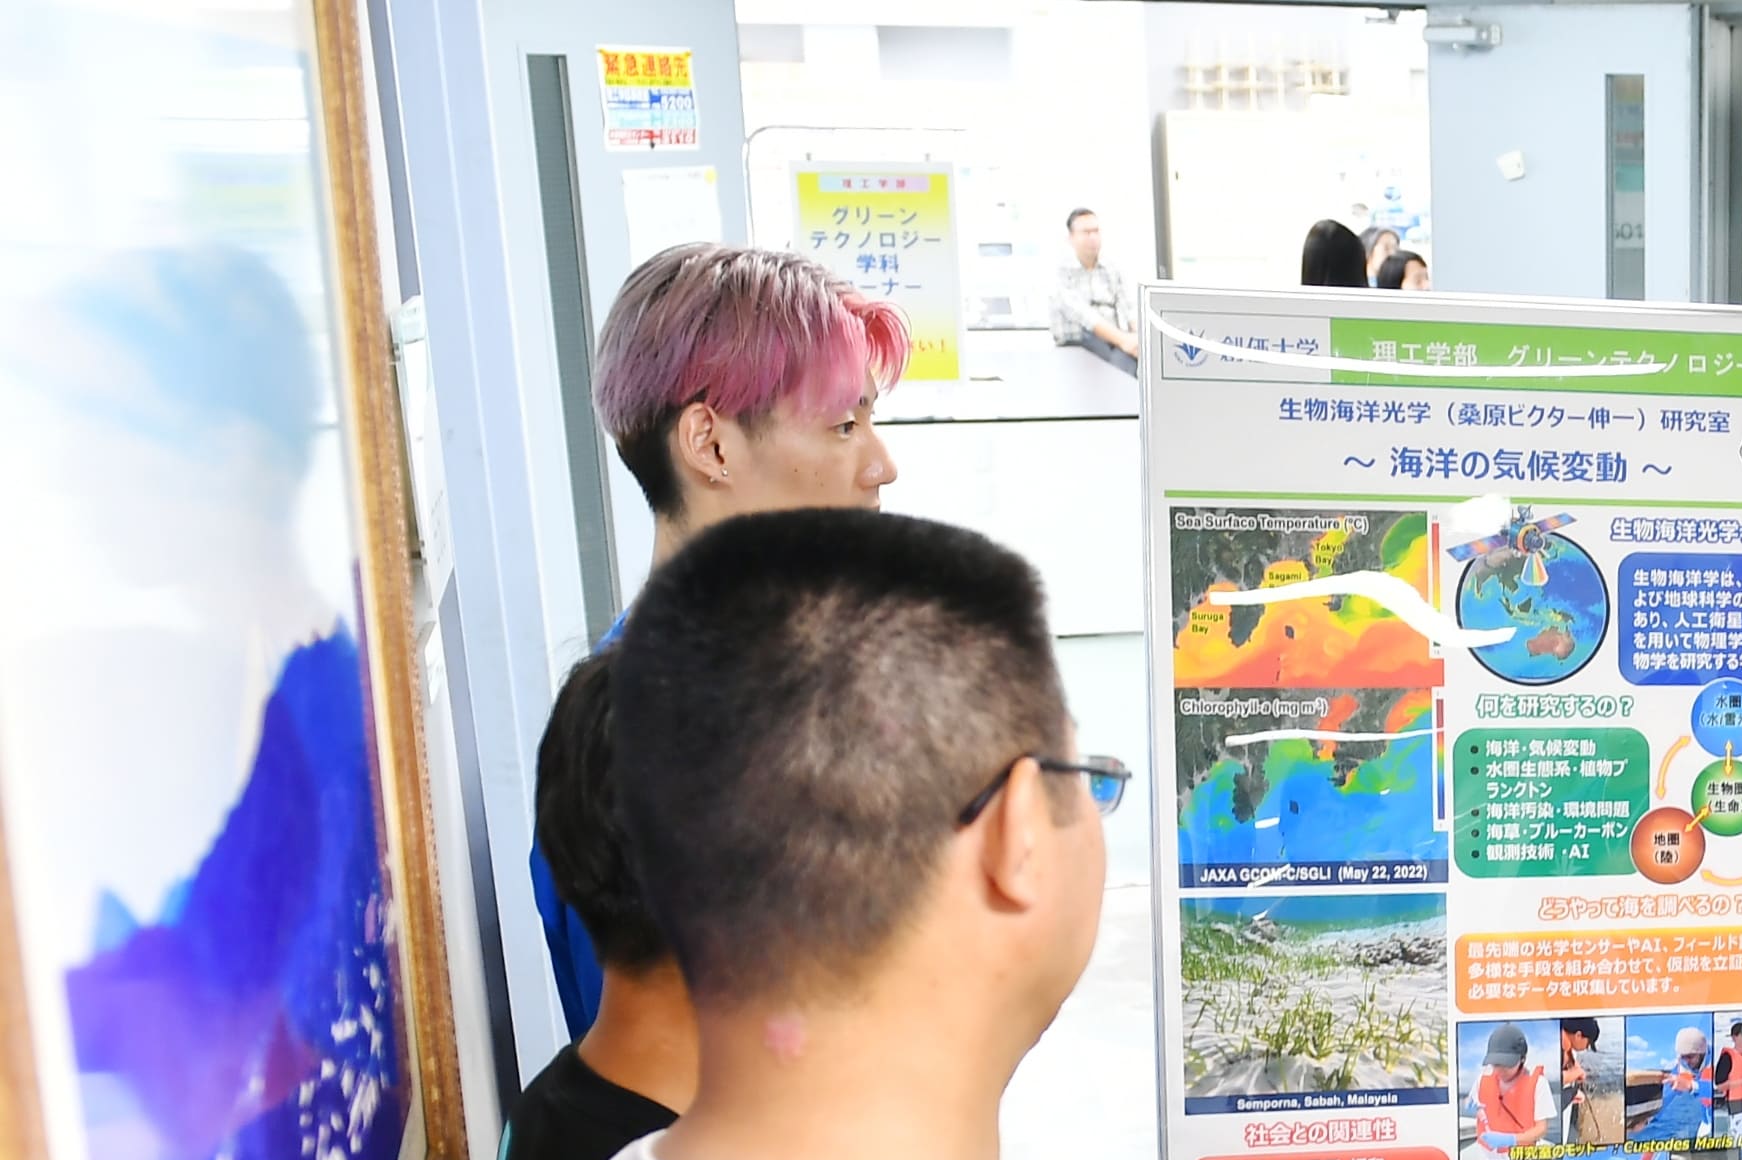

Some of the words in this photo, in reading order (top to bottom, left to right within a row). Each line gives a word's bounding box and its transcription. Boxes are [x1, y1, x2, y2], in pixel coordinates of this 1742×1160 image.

[832, 206, 918, 225] グリーン
[810, 231, 941, 249] テクノロジー
[856, 254, 900, 273] 学科
[1372, 340, 1478, 368] 理工学部
[1176, 514, 1202, 530] Sea
[1205, 515, 1257, 530] Surface
[1259, 516, 1341, 533] Temperature
[1315, 543, 1343, 554] Tokyo
[1315, 555, 1333, 566] Bay
[1269, 571, 1302, 582] Sagami
[1192, 612, 1225, 622] Suruga
[1192, 624, 1209, 635] Bay
[1716, 695, 1742, 708] 水圏
[1486, 740, 1596, 757] 海洋・気候変動
[1487, 782, 1553, 799] ランクトン
[1653, 832, 1680, 846] 地圏
[1200, 868, 1237, 883] JAXA
[1240, 866, 1331, 882] GCOM-C/SGLI
[1338, 865, 1369, 882] (May
[1372, 865, 1390, 881] 22,
[1394, 864, 1428, 881] 2022)
[1237, 1098, 1301, 1111] Semporna,
[1304, 1095, 1345, 1108] Sabah,
[1348, 1092, 1398, 1107] Malaysia
[1244, 1117, 1397, 1147] 社会との関連性
[1624, 1137, 1690, 1154] Custodes
[1694, 1134, 1734, 1150] Maris
